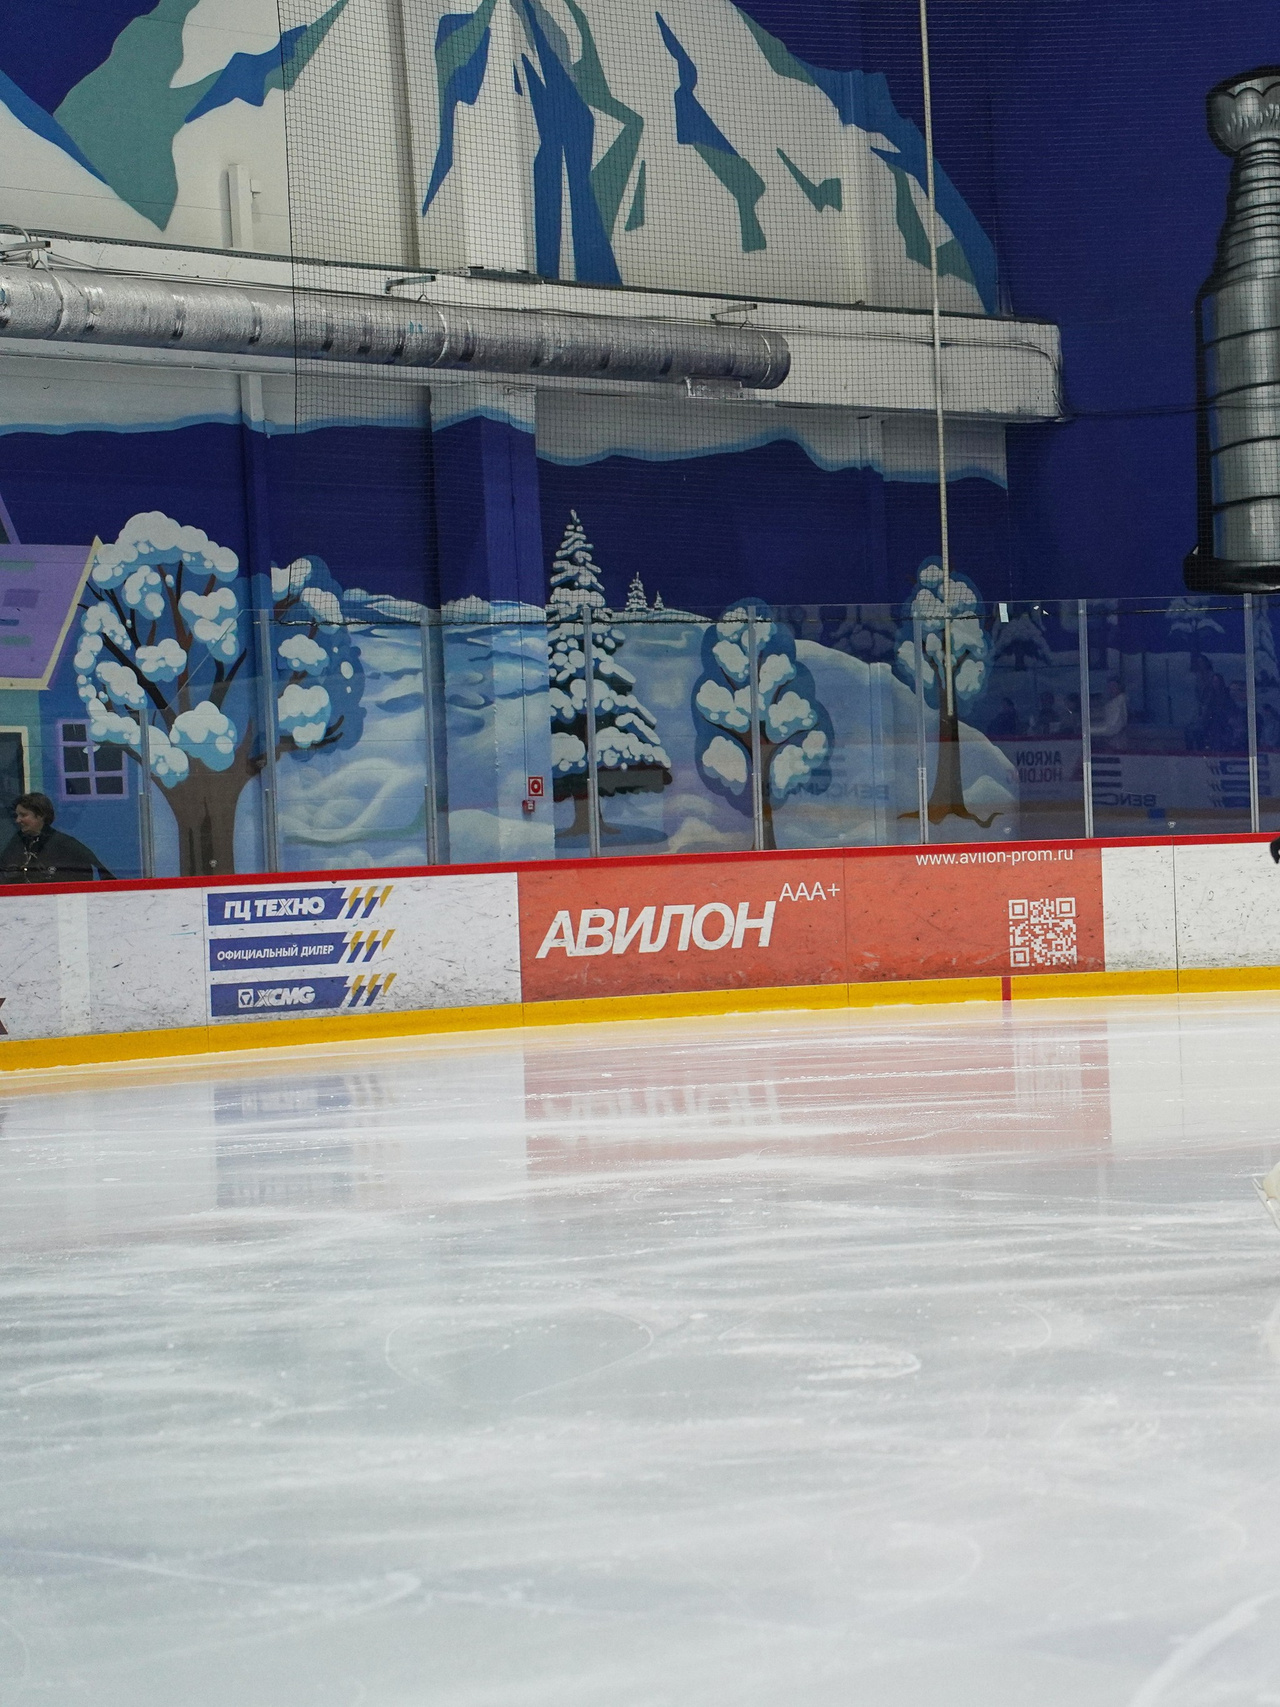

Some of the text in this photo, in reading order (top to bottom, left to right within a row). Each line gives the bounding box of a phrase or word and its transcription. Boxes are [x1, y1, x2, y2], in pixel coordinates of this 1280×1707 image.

[916, 849, 1073, 865] www.avilon-prom.ru
[224, 897, 325, 920] ГЦ ТЕХНО
[535, 900, 776, 958] АВИЛОН
[217, 944, 334, 961] ОФИЦИАЛЬНЫЙ ДИЛЕР
[254, 986, 316, 1007] XCMG
